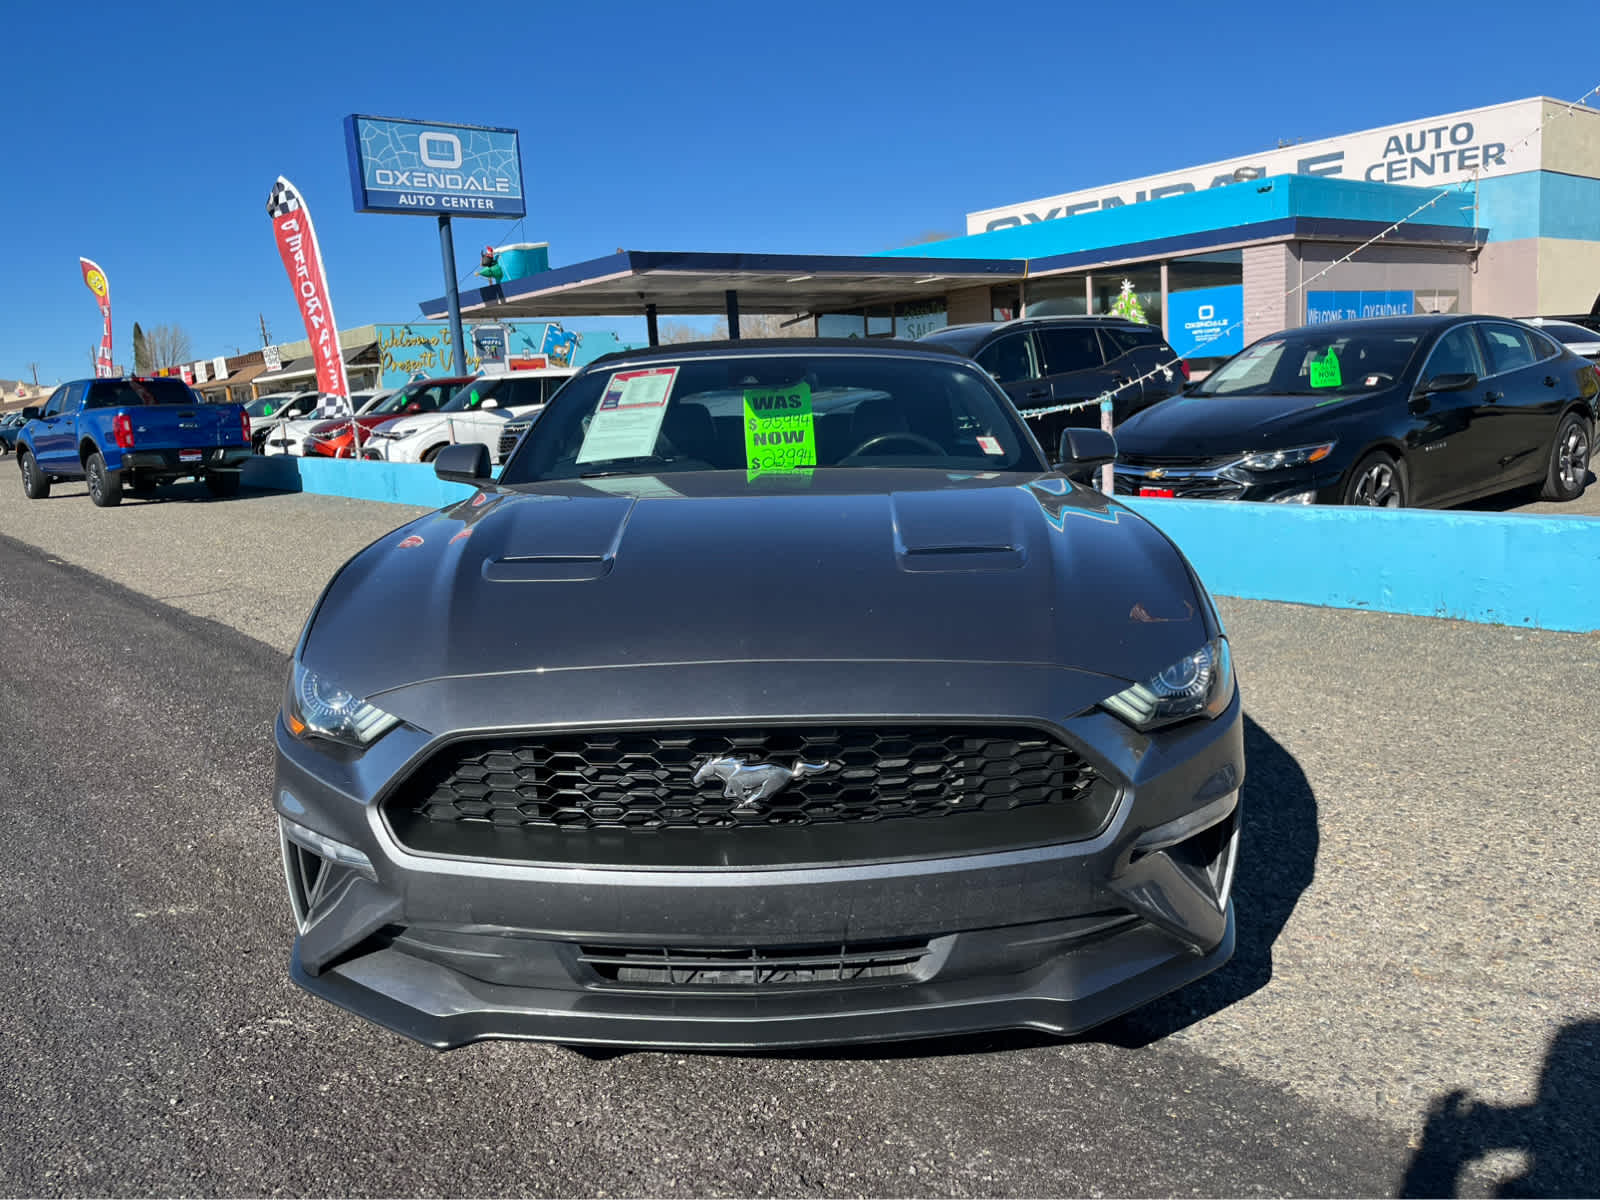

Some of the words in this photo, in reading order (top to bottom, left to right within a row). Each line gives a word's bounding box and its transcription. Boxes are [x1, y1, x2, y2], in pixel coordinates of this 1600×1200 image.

[1383, 122, 1474, 158] AUTO
[1365, 142, 1506, 182] CENTER
[376, 170, 509, 192] OXENDALE
[399, 194, 435, 206] AUTO
[441, 196, 494, 209] CENTER
[1308, 307, 1342, 325] WELCOME
[1347, 310, 1357, 321] TO
[378, 328, 440, 352] Welcome
[379, 351, 437, 376] Prescott
[752, 395, 802, 410] WAS
[753, 431, 805, 446] NOW
